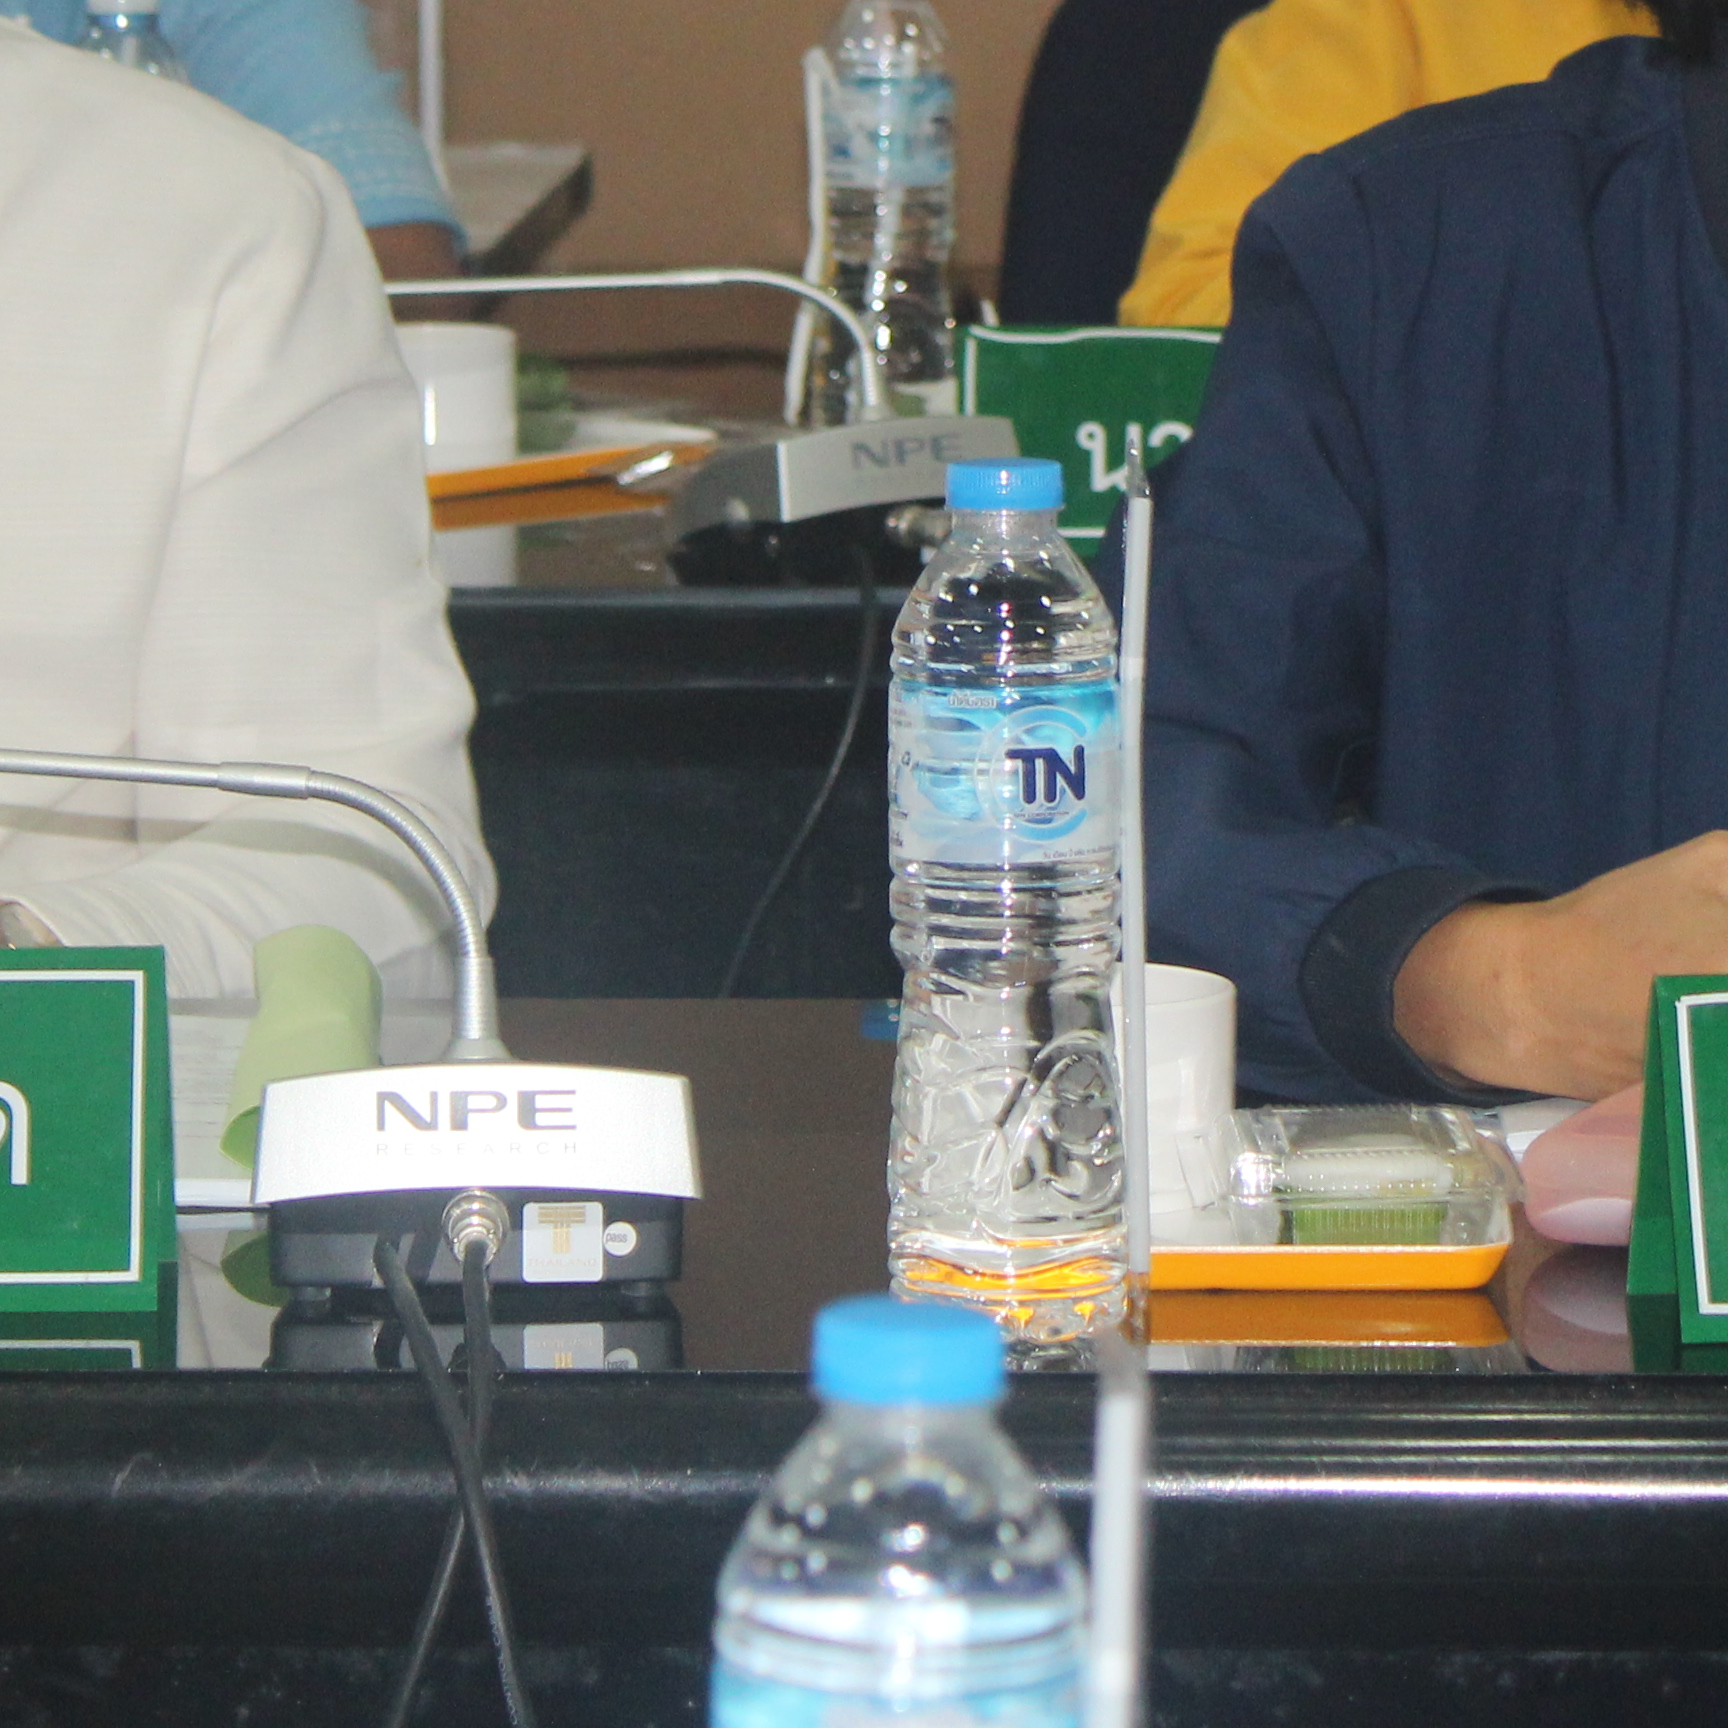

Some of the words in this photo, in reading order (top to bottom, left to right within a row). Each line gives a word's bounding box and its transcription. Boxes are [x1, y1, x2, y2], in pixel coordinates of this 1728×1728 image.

[851, 432, 962, 469] NPE
[1005, 744, 1086, 805] TN
[376, 1089, 577, 1132] NPE
[376, 1141, 577, 1157] RESEARCH
[605, 1231, 628, 1245] pass
